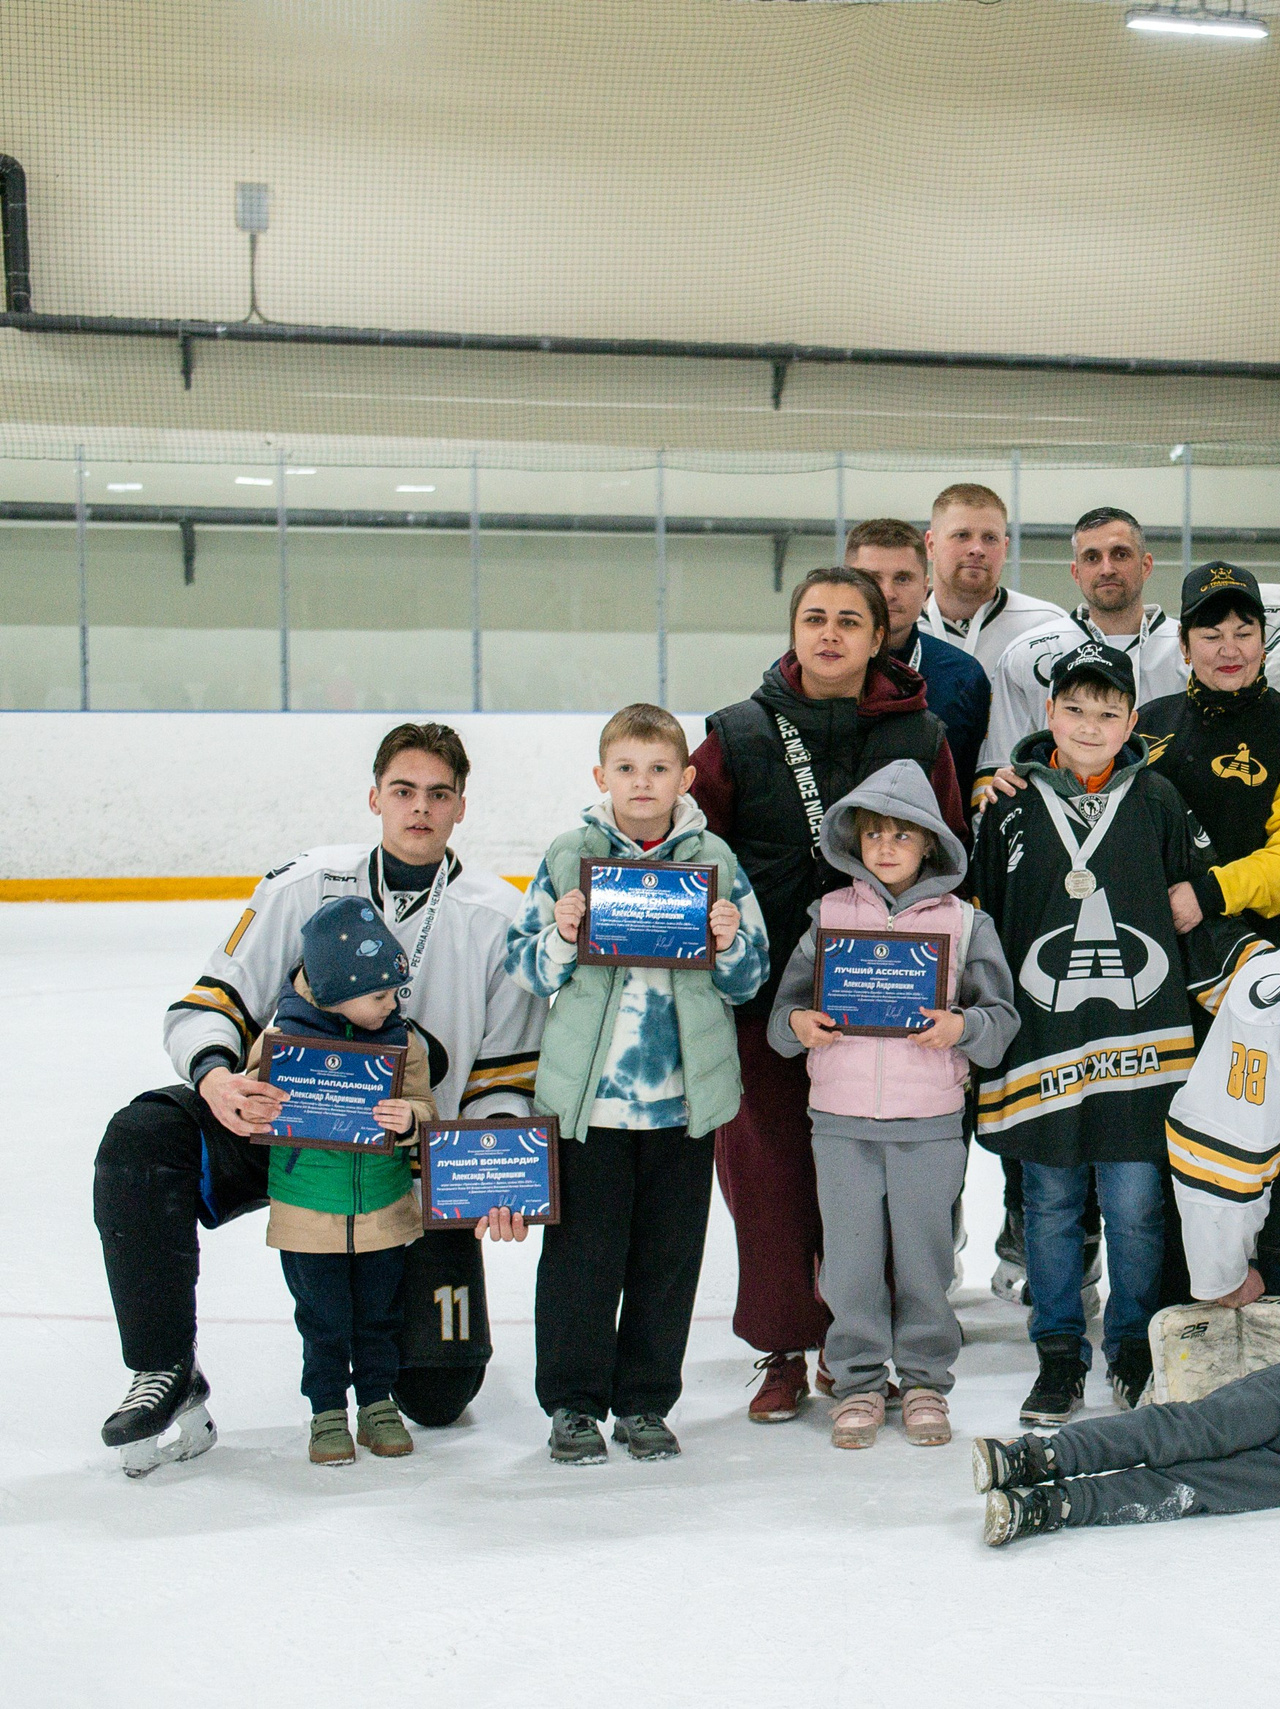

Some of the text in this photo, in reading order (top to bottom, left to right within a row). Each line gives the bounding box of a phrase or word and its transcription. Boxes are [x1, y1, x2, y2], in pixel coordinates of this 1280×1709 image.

[794, 766, 819, 800] NICE
[409, 907, 437, 968] РЕГИОНАЛЬНЫЙ
[834, 966, 926, 977] ЛУЧШИЙ АССИСТЕНТ
[843, 979, 875, 990] Александр
[1039, 1045, 1161, 1101] ДРУЖБА
[1226, 1041, 1268, 1106] 88
[277, 1075, 384, 1092] ЛУЧШИЙ НАПАДАЮЩИЙ
[290, 1089, 323, 1101] Александр
[437, 1157, 540, 1168] ЛУЧШИЙ БОМБАРДИР
[452, 1172, 485, 1181] Александр
[433, 1285, 470, 1341] 11
[1181, 1321, 1209, 1339] 25
